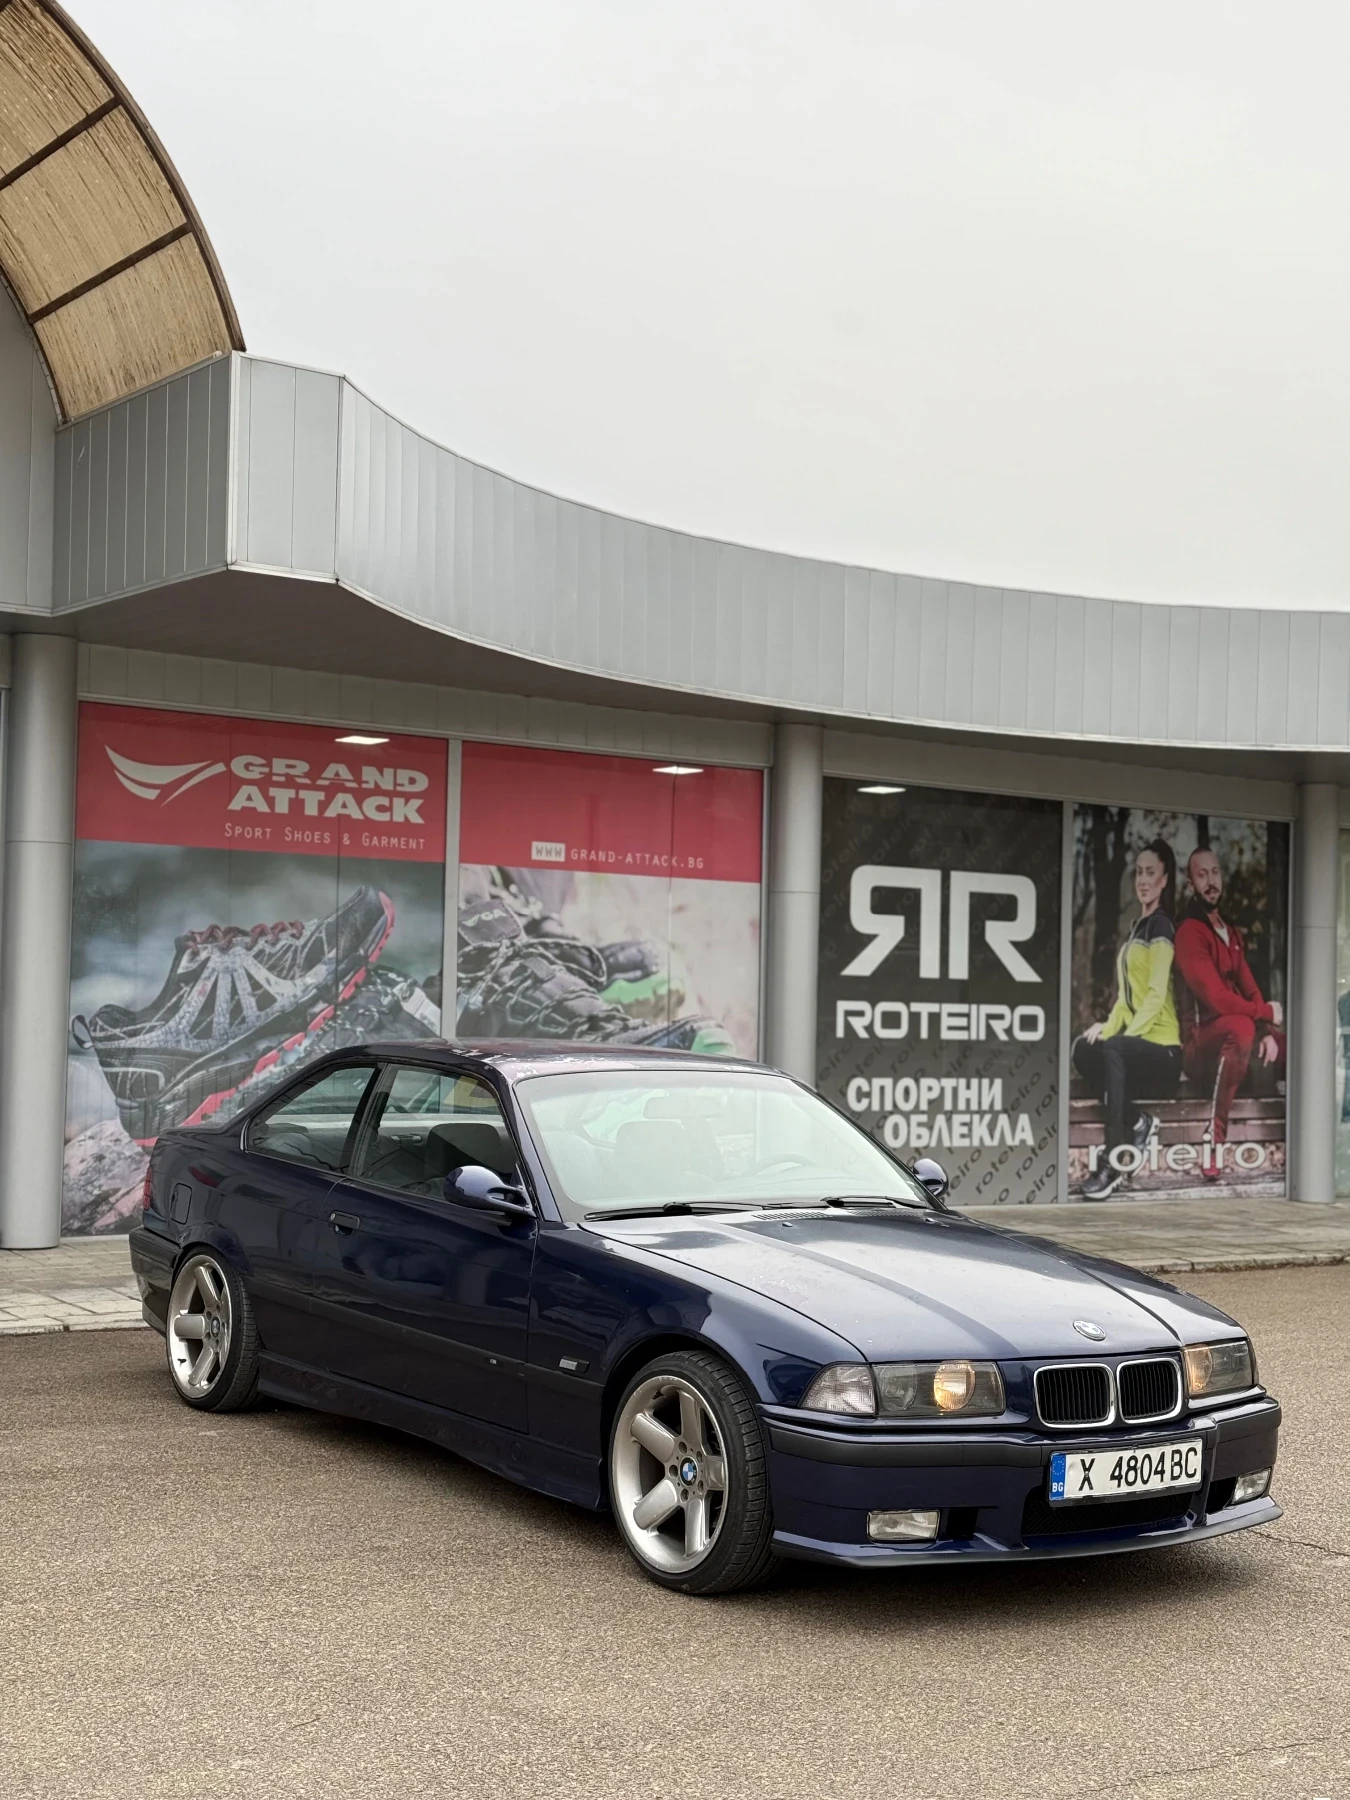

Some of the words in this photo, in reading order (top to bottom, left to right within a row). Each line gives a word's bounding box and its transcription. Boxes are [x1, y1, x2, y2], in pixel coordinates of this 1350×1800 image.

[230, 755, 429, 792] GRAND
[227, 785, 425, 824] ATTACK
[342, 832, 350, 845] &
[535, 845, 563, 859] WWW
[571, 848, 704, 869] GRAND-ATTACK.BG
[835, 1000, 1046, 1041] ROTEIRO
[847, 1077, 1003, 1111] СПОРТНИ
[883, 1113, 1035, 1148] ОБЛЕКЛА
[1015, 1121, 1058, 1180] roteir
[1088, 1133, 1266, 1172] roteiro
[1052, 1482, 1064, 1492] BG
